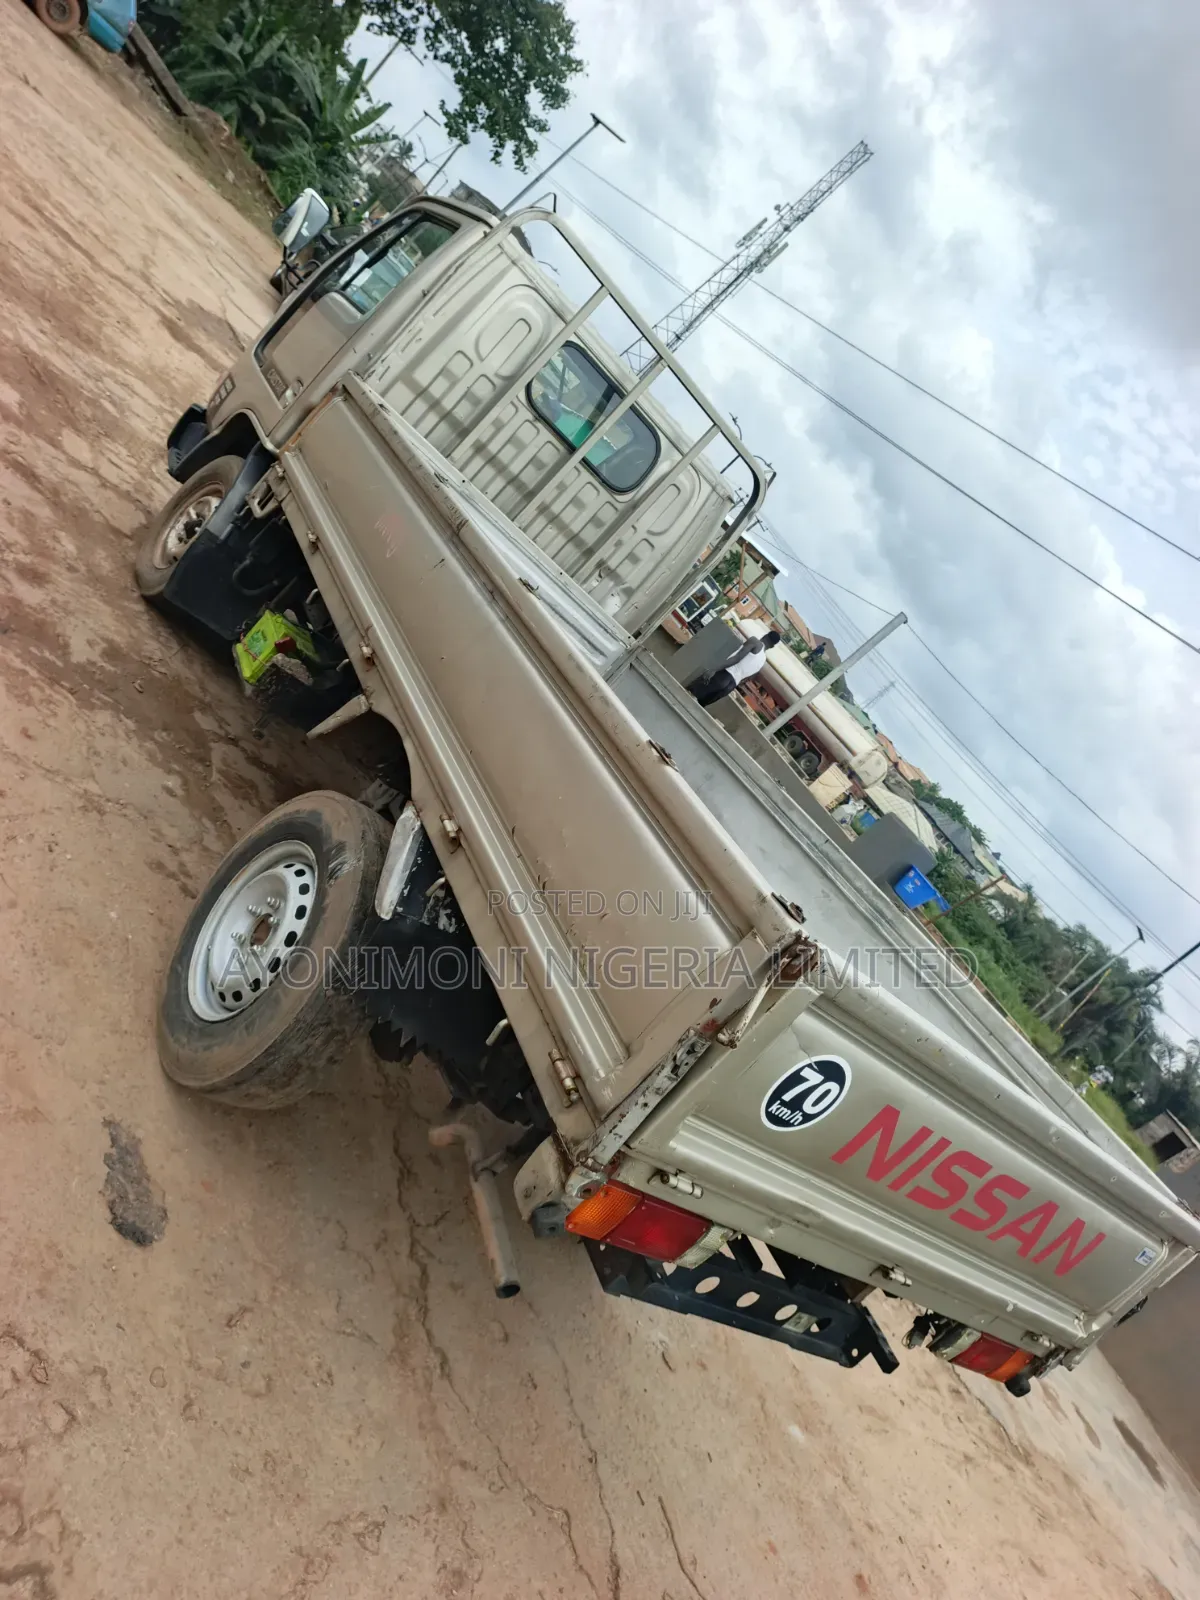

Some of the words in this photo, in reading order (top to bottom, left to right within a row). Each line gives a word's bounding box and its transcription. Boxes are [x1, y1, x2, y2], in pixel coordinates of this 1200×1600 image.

[767, 1100, 804, 1126] km/h
[781, 1066, 841, 1115] 70
[829, 1103, 1107, 1278] NISSAN
